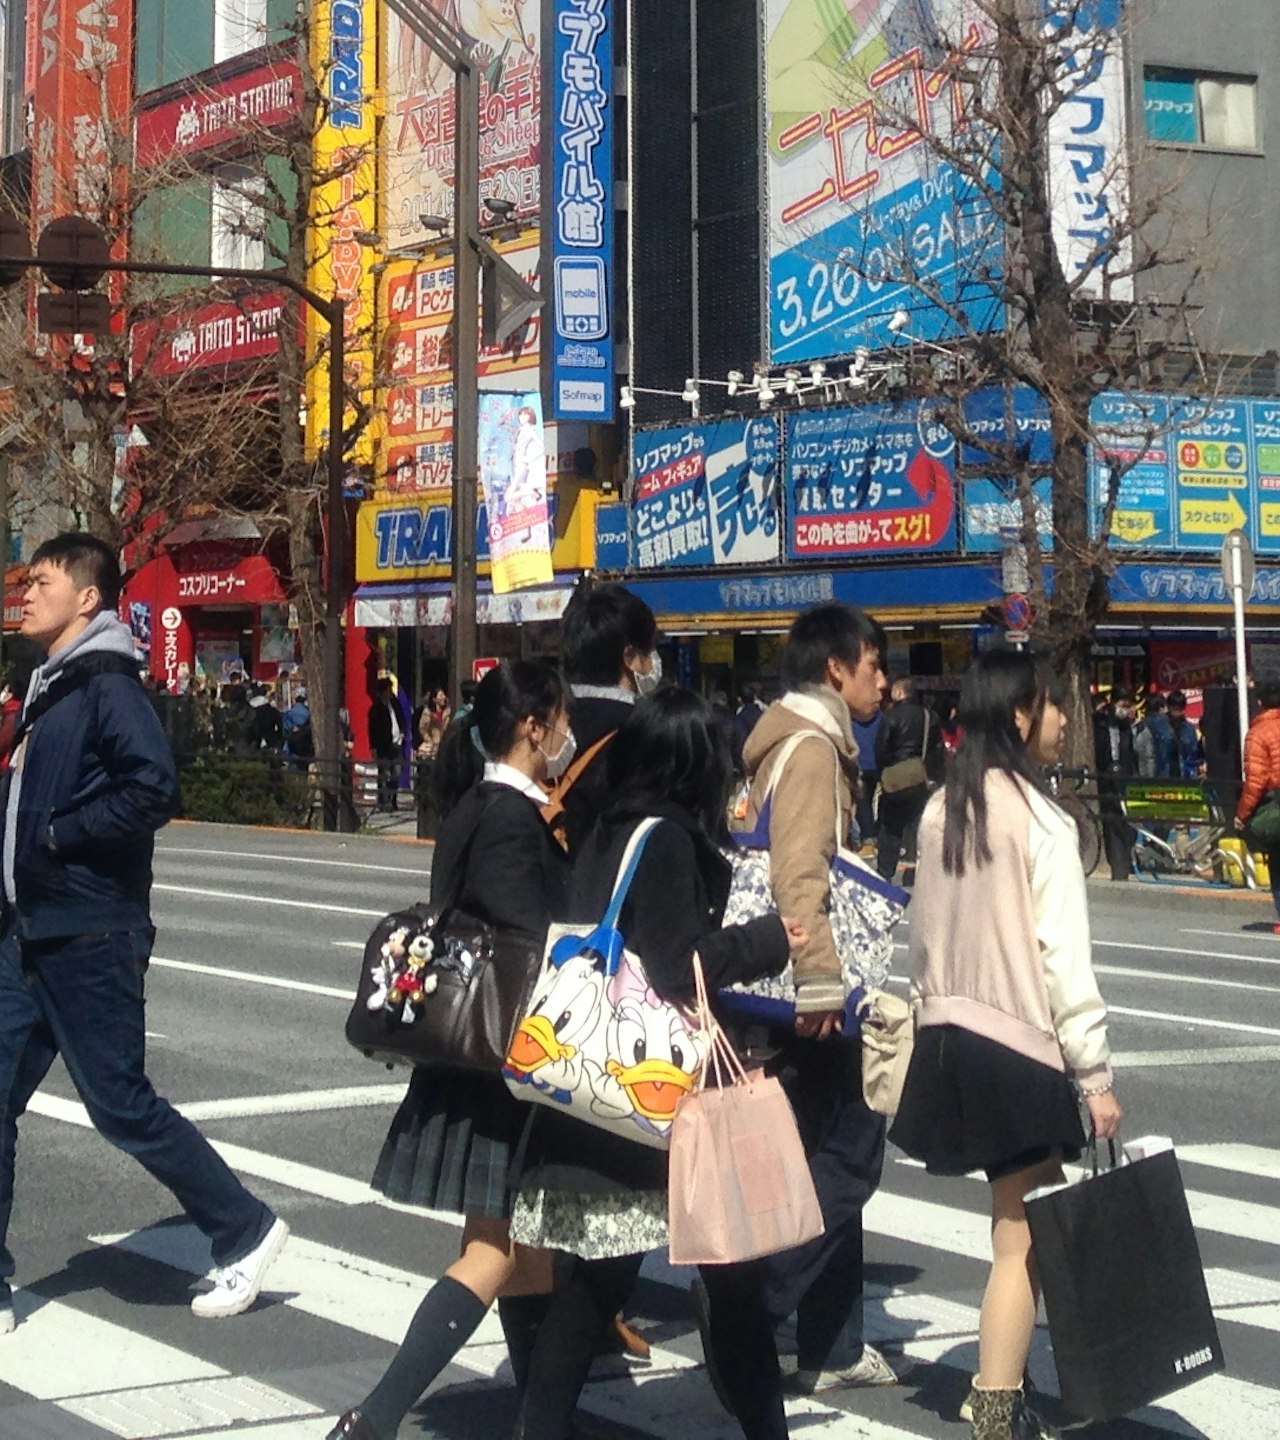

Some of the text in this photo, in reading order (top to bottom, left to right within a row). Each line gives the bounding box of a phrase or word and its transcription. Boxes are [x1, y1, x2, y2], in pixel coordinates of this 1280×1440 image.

[202, 73, 295, 138] TAITO STATION
[1144, 98, 1194, 115] ソフマップ
[777, 21, 984, 225] ニセコイ
[564, 288, 597, 301] mobile
[196, 303, 282, 353] TAITO STATIO
[562, 388, 603, 404] Sofmap
[1016, 418, 1052, 432] ソフマ
[636, 488, 706, 538] どこよりも
[795, 513, 932, 547] この角を曲がってスグ!
[1173, 1345, 1214, 1375] K-BOOKS
